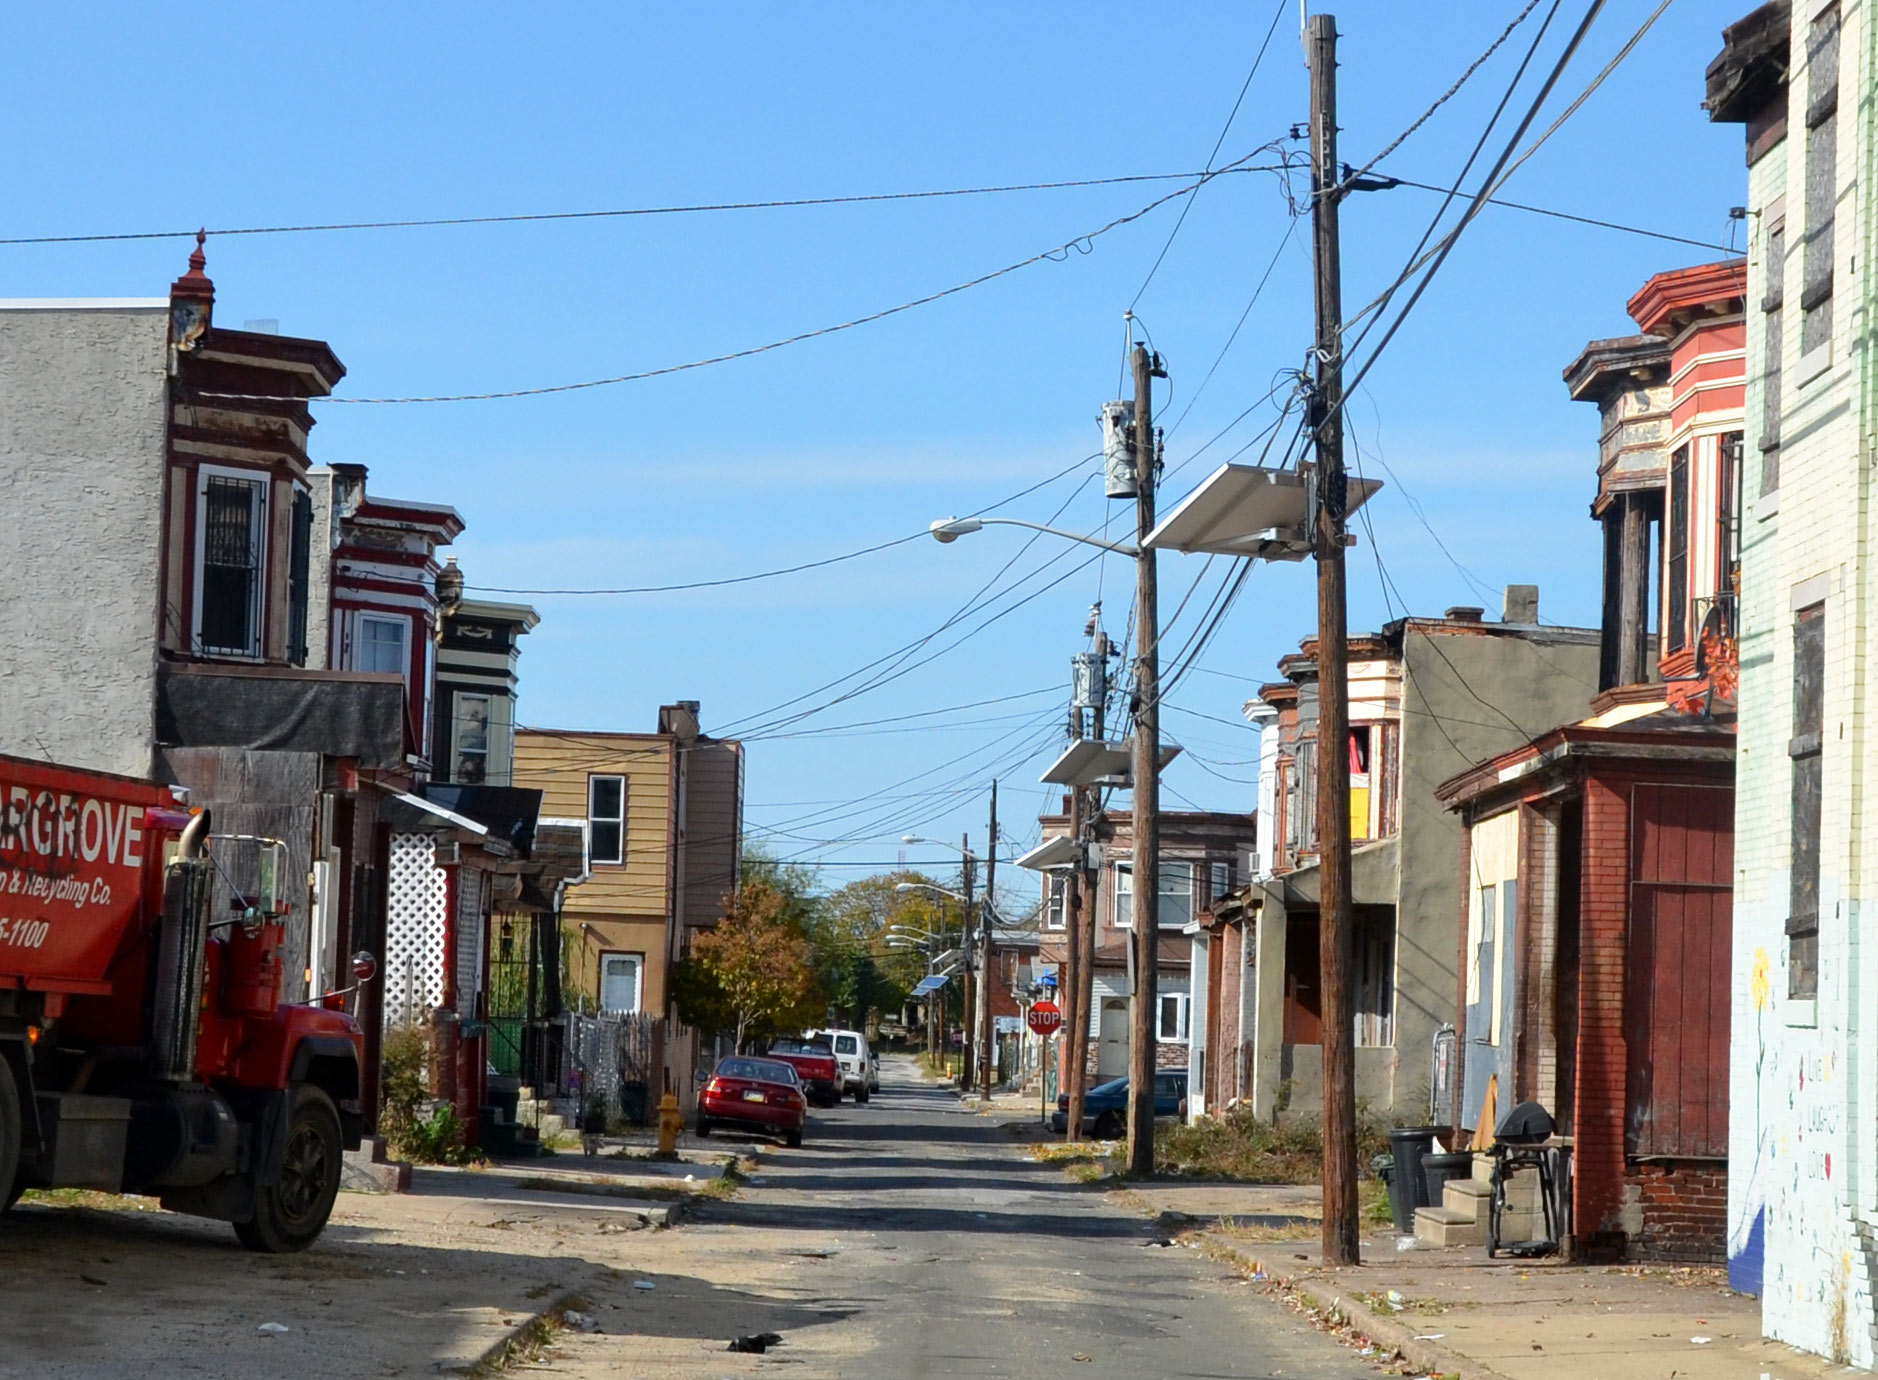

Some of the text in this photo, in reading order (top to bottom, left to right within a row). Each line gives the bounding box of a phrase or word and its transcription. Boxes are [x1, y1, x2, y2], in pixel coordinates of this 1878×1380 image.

[8, 867, 20, 894] &
[21, 869, 90, 909] Recycling
[90, 876, 111, 905] Co.
[1029, 1011, 1060, 1025] STOP
